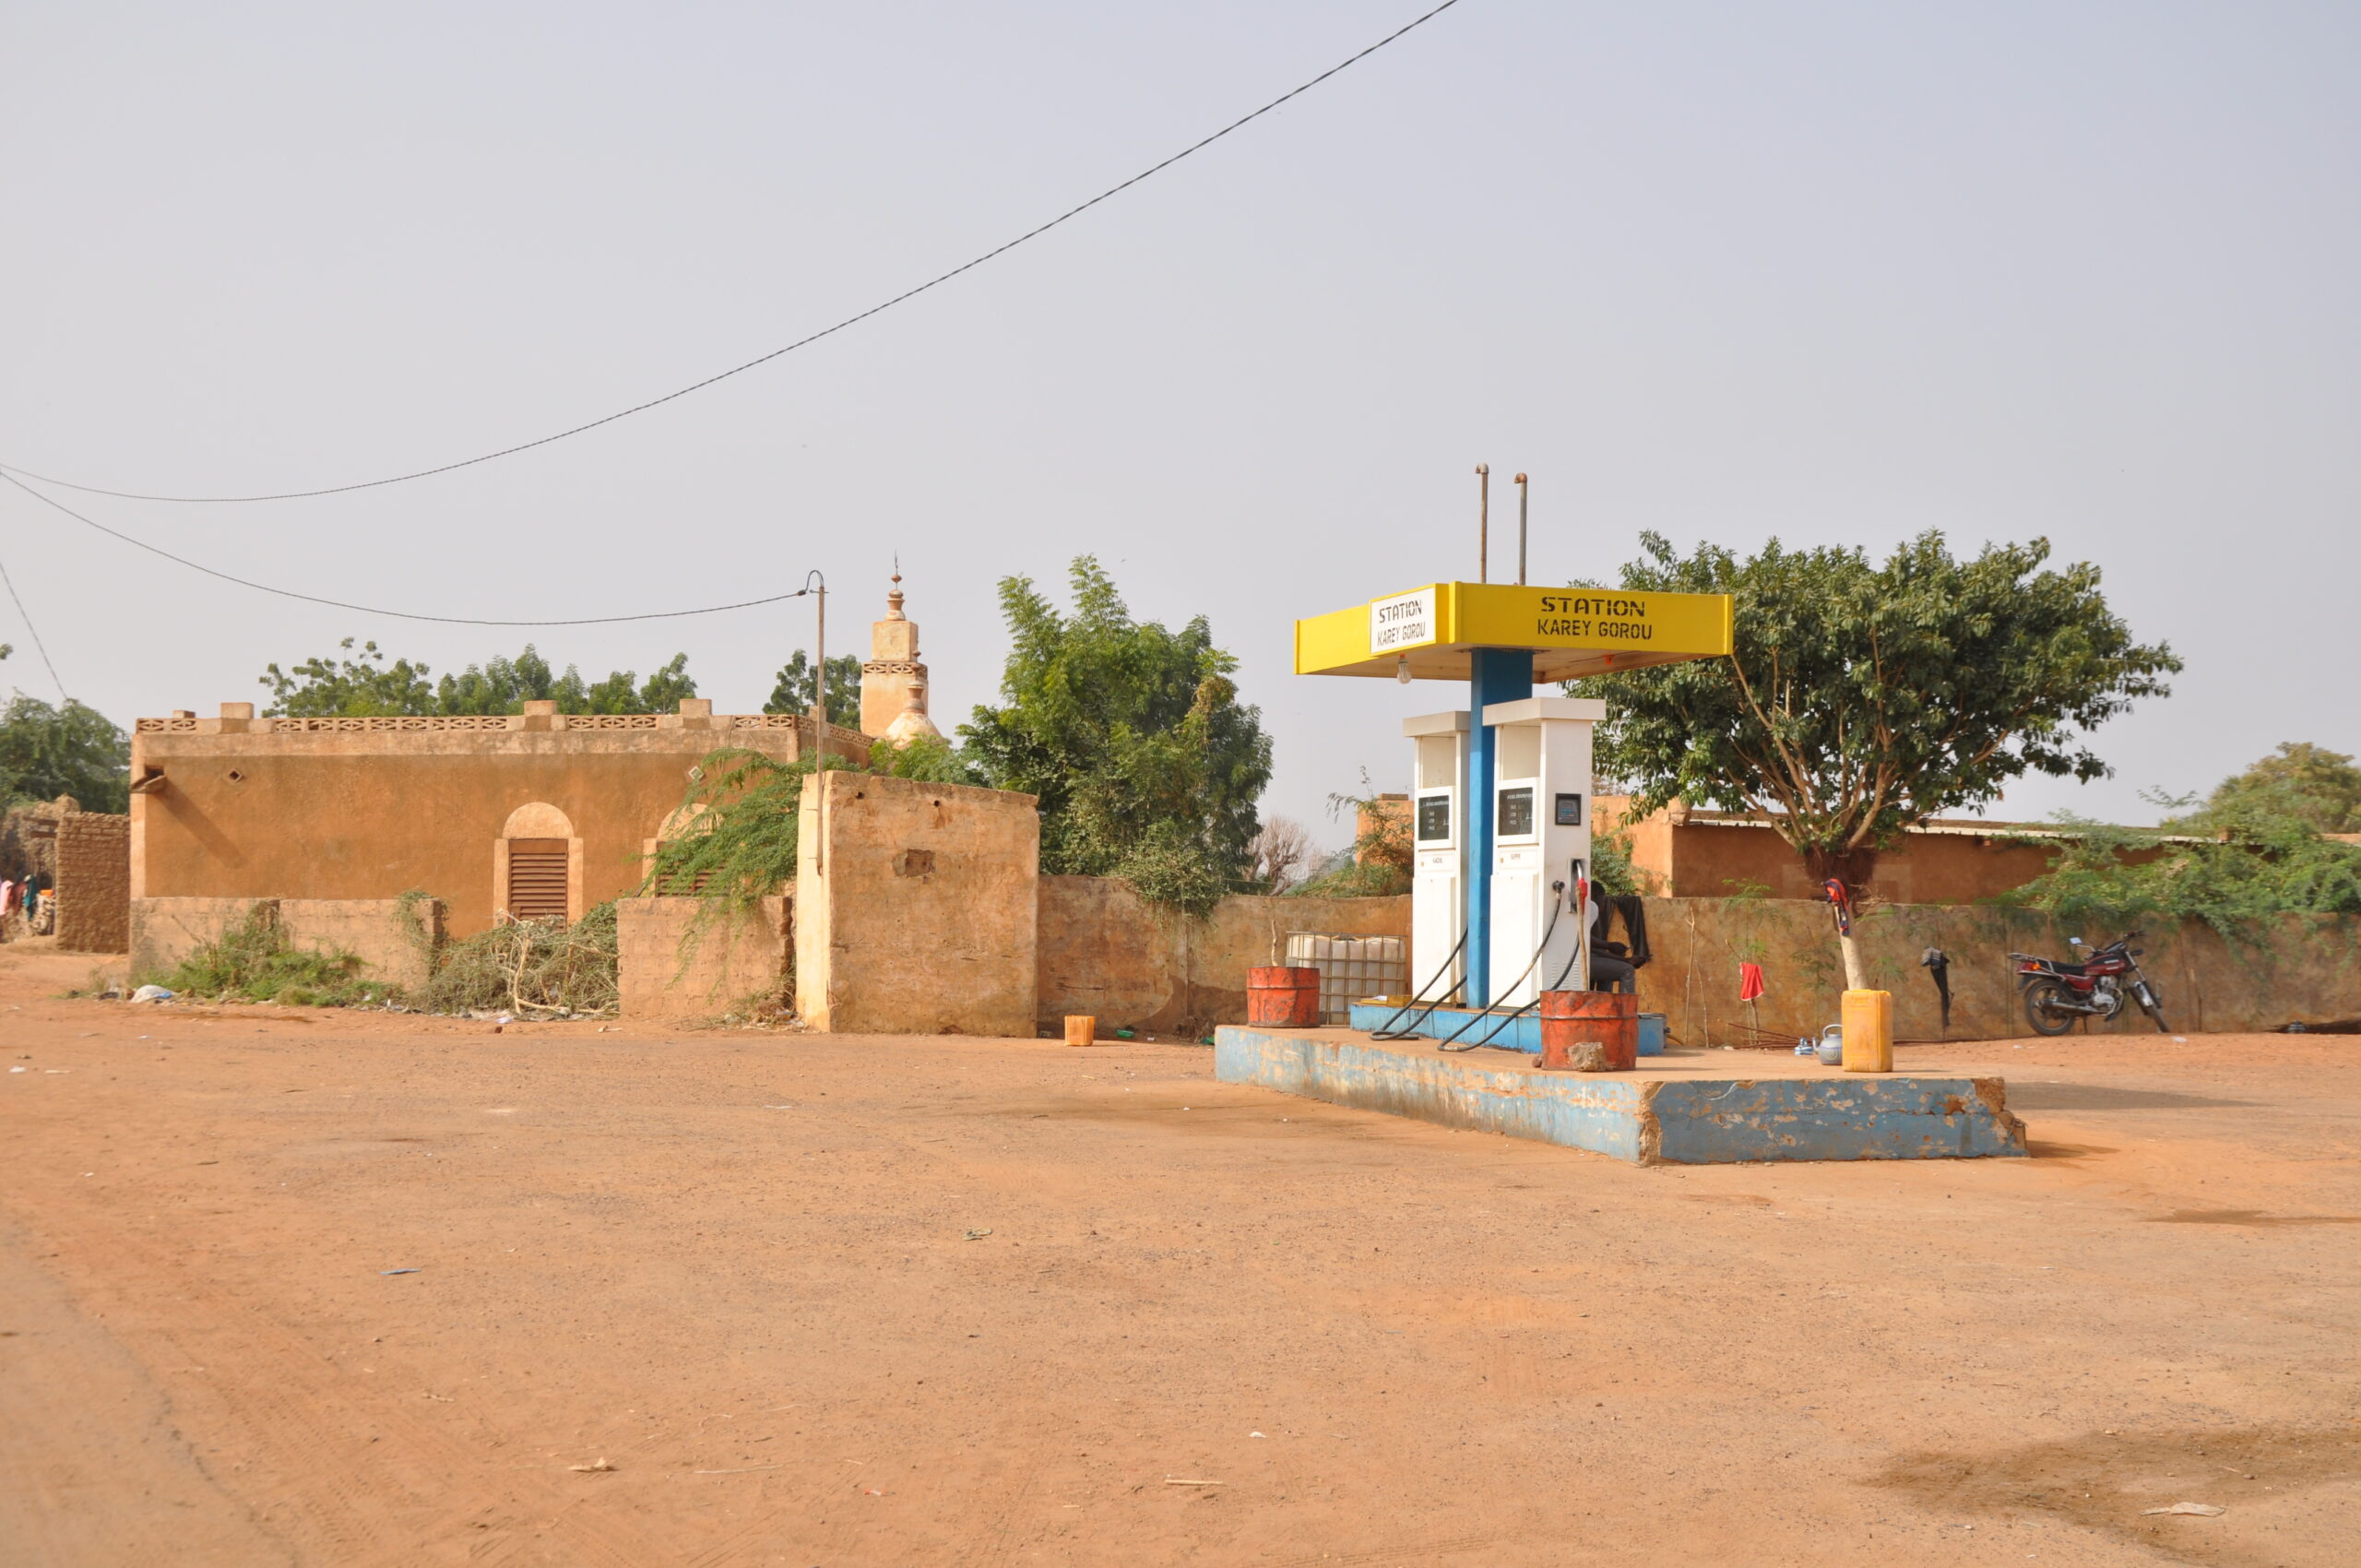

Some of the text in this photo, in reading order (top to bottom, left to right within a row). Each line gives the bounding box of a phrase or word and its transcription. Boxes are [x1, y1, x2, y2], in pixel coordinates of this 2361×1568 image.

[1380, 600, 1421, 624] STATION
[1541, 597, 1644, 617] STATION
[1378, 621, 1425, 647] KAREY GOROU
[1537, 619, 1652, 640] KAREY GOROU
